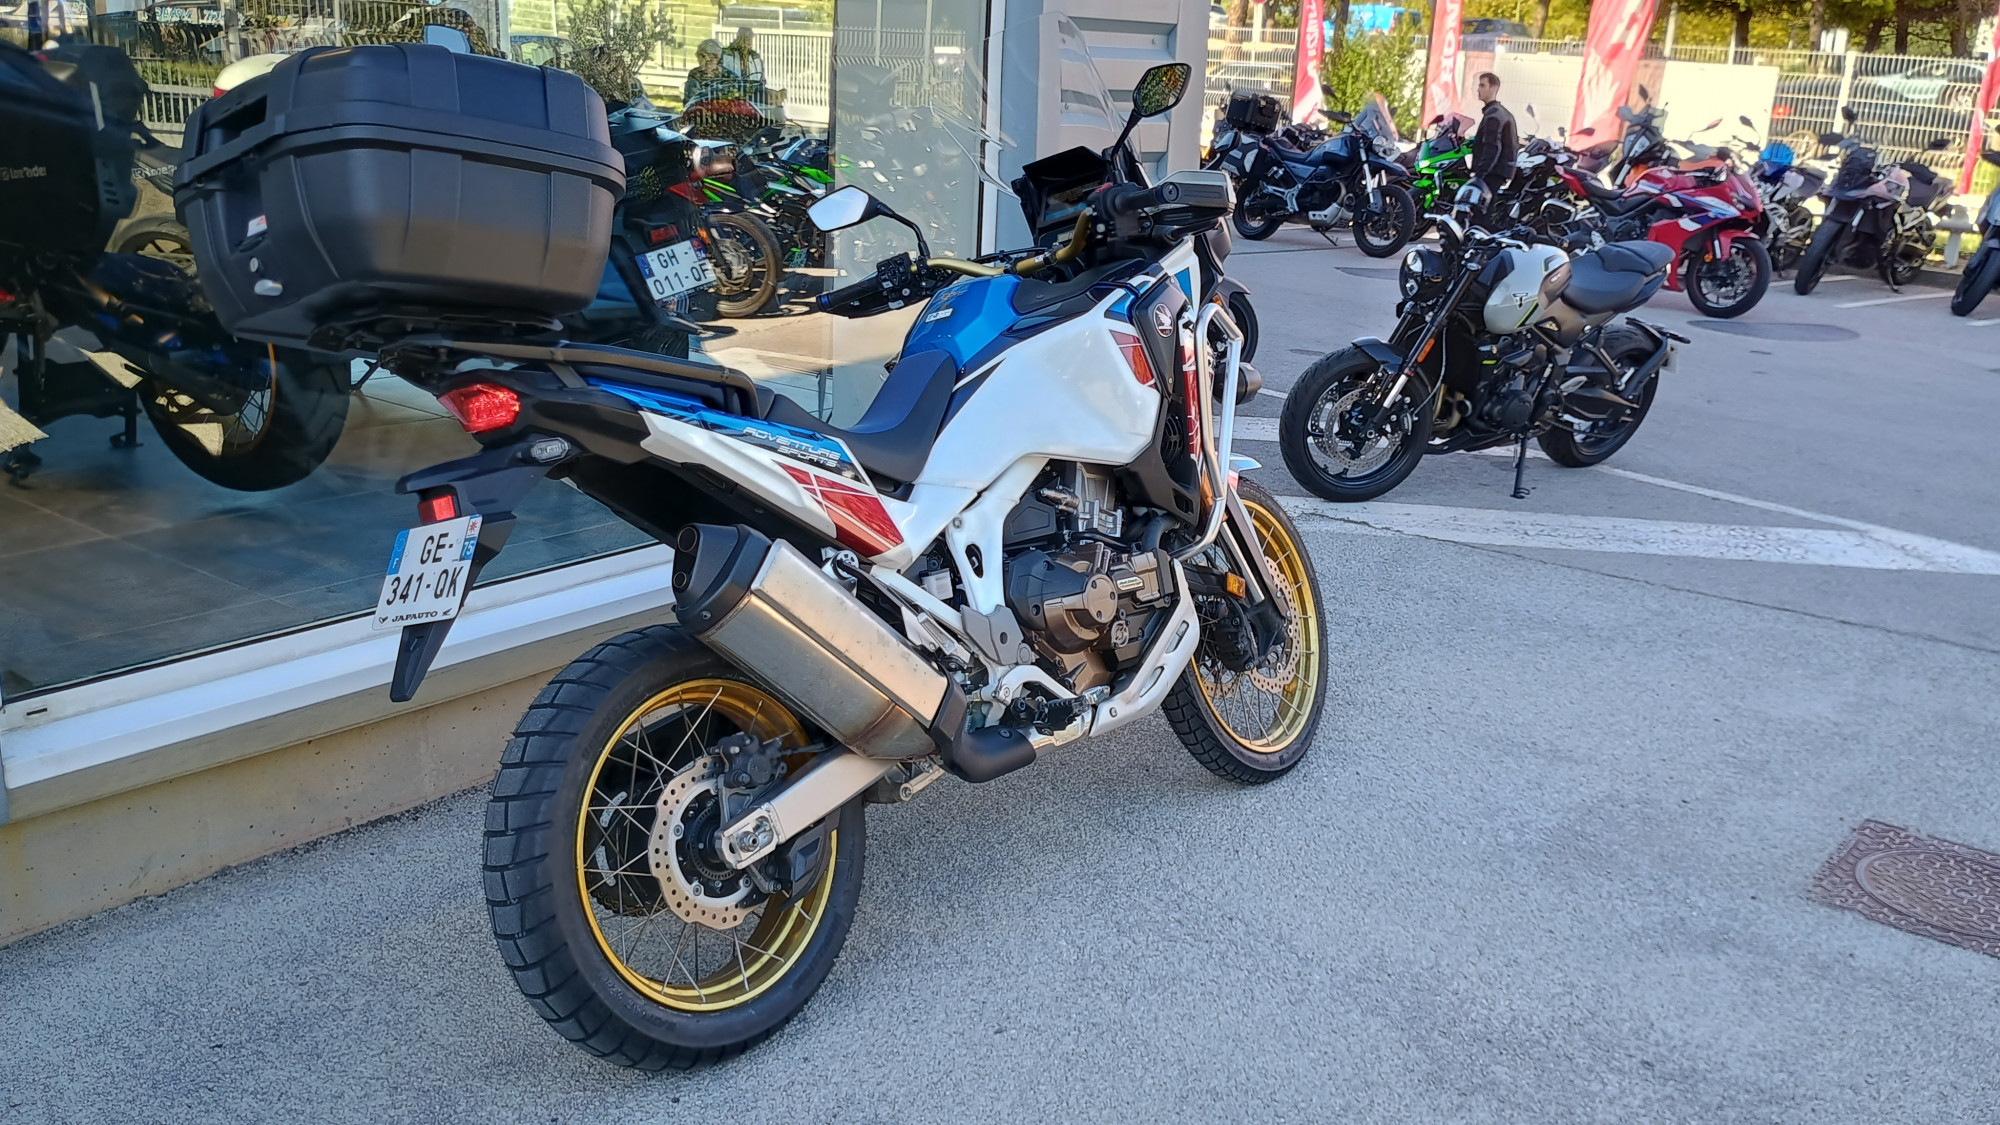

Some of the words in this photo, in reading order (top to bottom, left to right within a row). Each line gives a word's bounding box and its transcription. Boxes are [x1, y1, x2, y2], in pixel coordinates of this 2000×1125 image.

[653, 262, 709, 296] 011-QF
[743, 427, 841, 461] ADVENTURE
[777, 445, 838, 468] SPORTS
[386, 566, 464, 606] 341-QK
[391, 610, 439, 623] JAPAUTO
